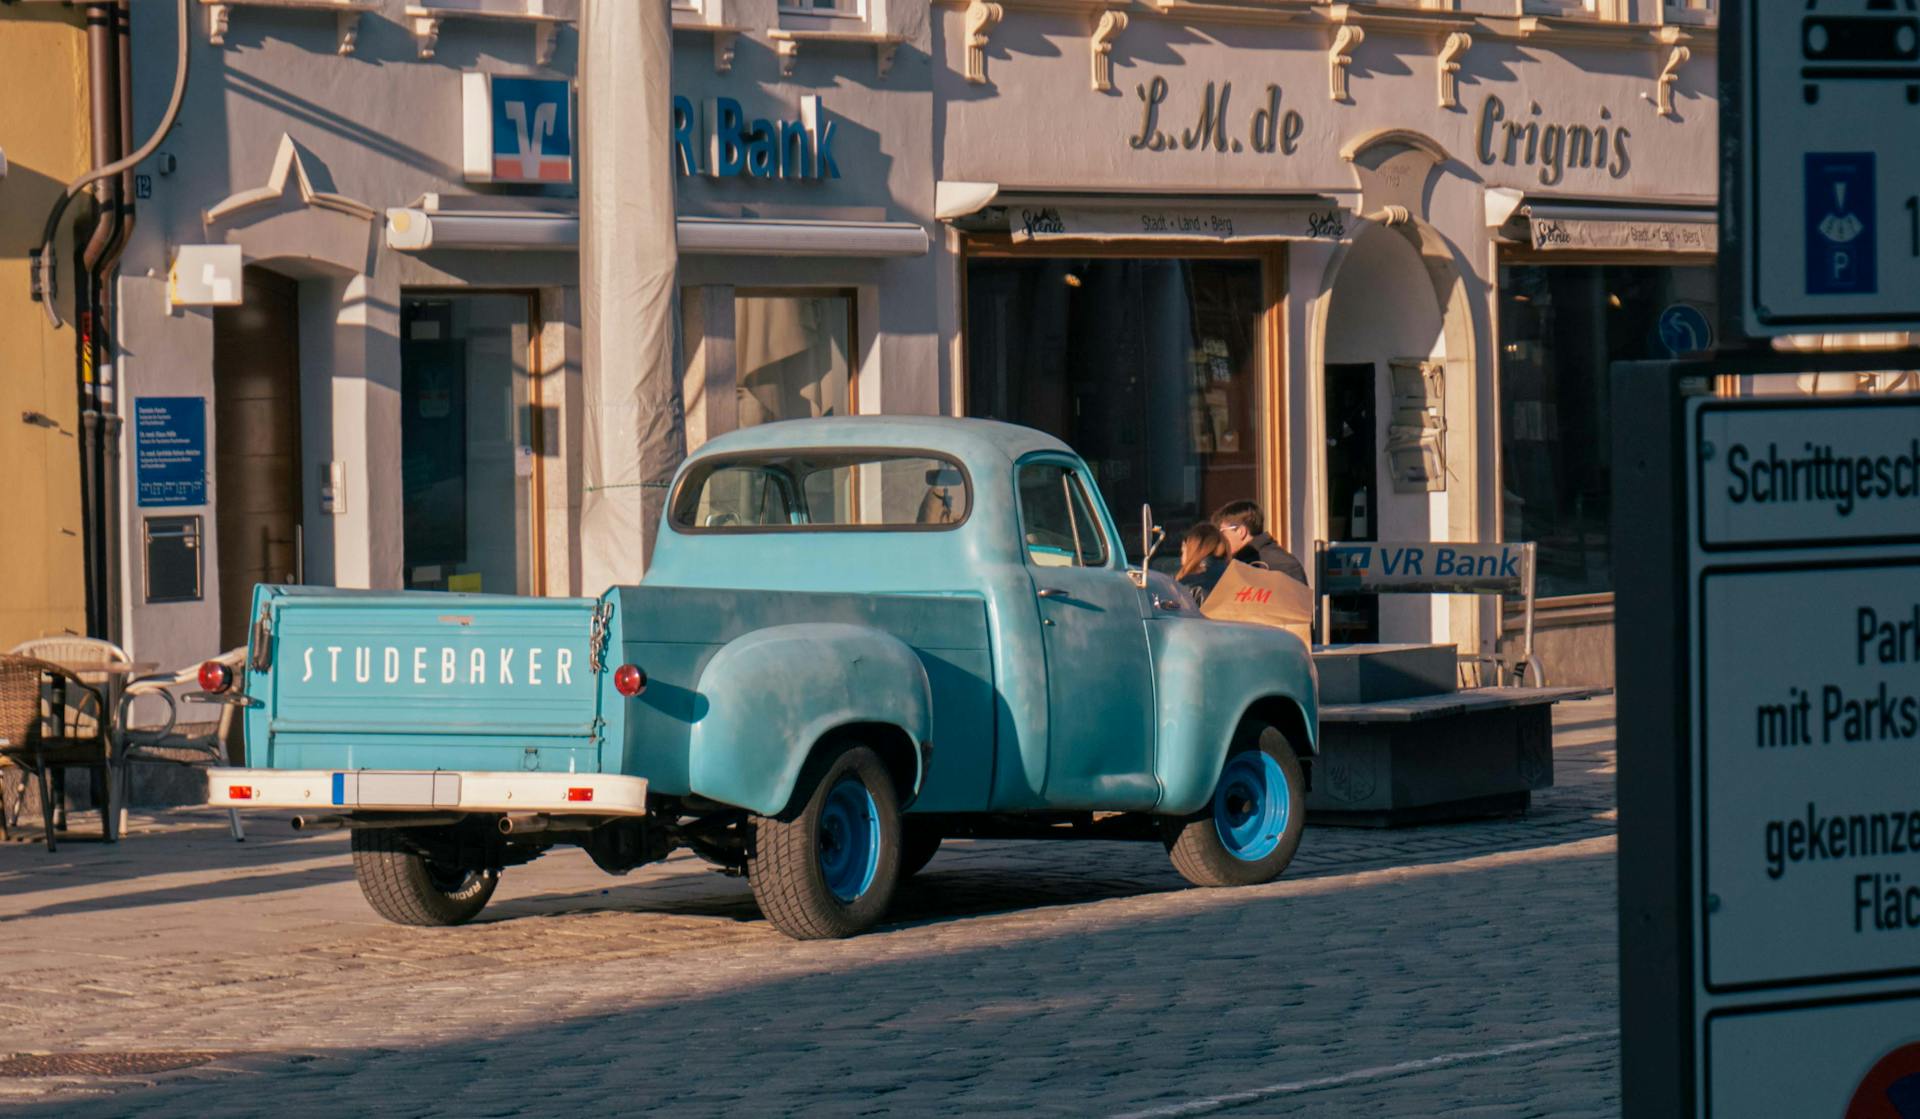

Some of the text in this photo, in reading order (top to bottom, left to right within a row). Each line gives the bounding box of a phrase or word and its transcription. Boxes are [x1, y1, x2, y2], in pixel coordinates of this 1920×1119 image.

[714, 95, 841, 179] Bank
[1251, 83, 1304, 155] de
[1476, 93, 1631, 186] Crignis
[137, 175, 150, 197] 12
[1141, 215, 1233, 235] Stadt Land Berg
[1834, 252, 1849, 279] P
[1380, 547, 1519, 577] VR Bank
[302, 646, 573, 685] STUDEBAKER
[1757, 681, 1918, 748] mit Parks
[1855, 872, 1920, 933] Fläc
